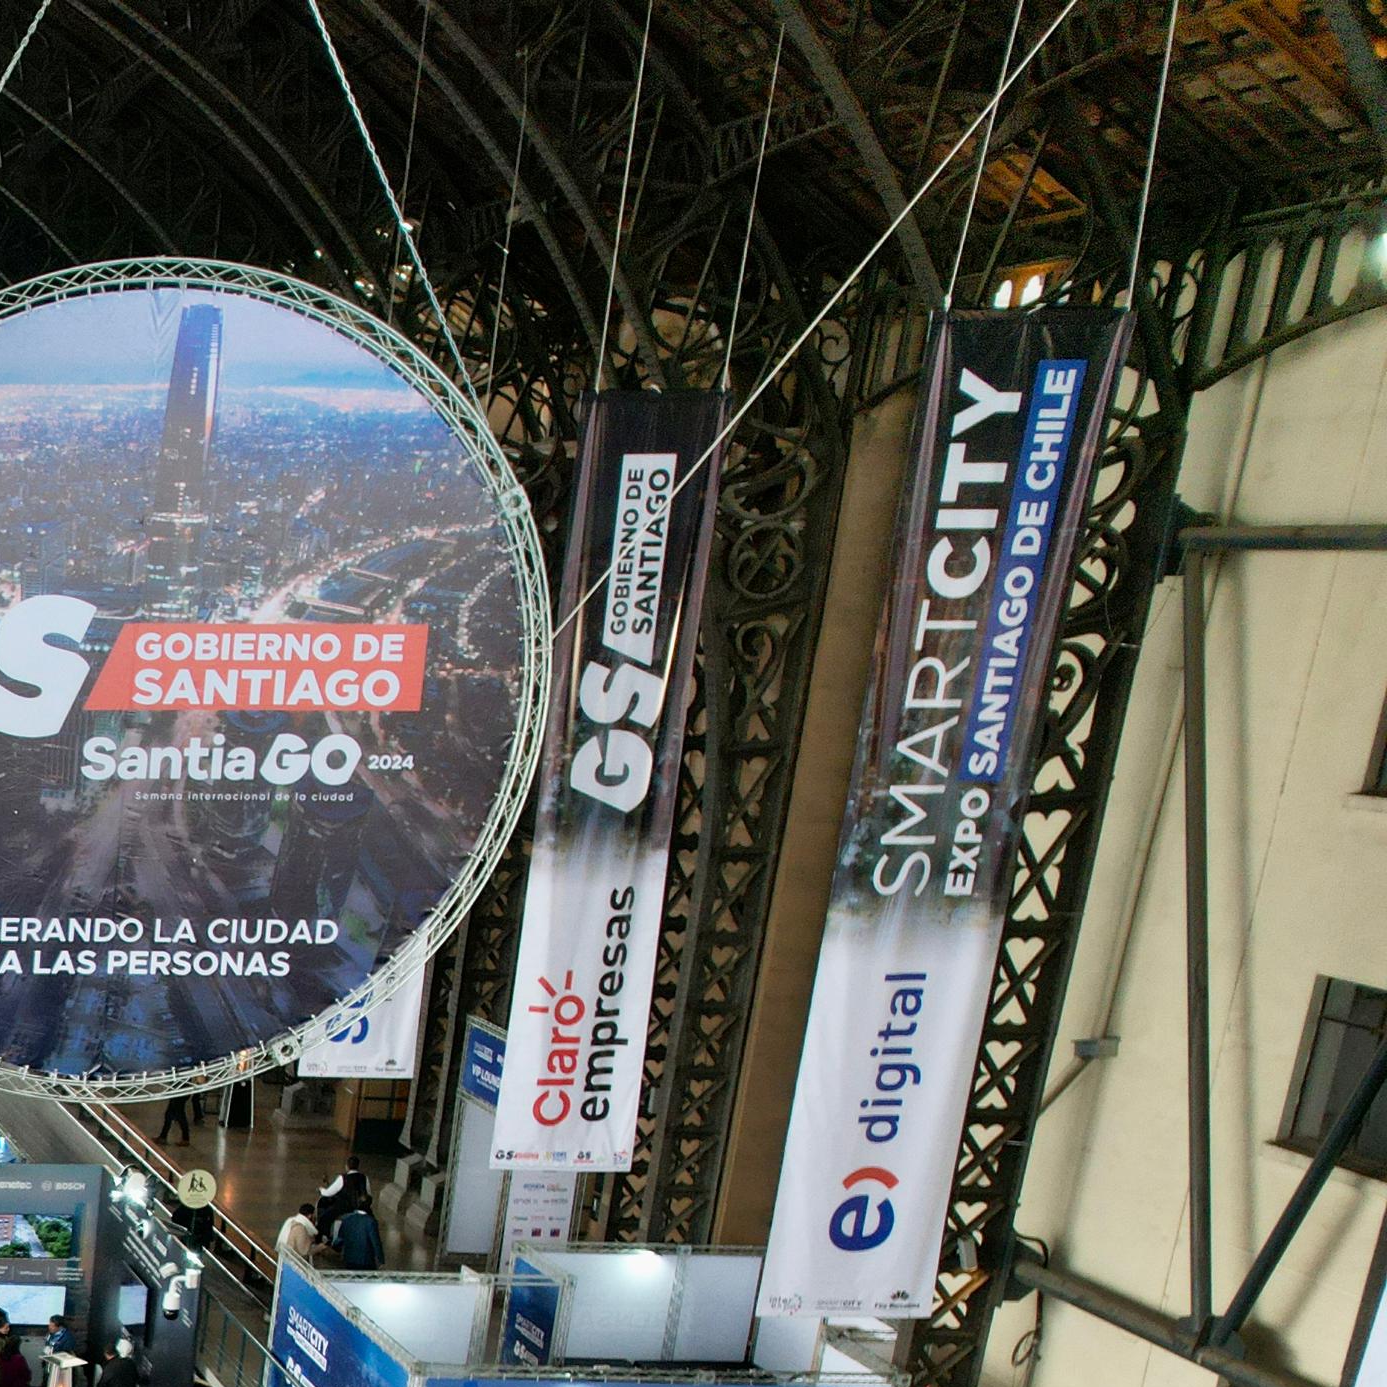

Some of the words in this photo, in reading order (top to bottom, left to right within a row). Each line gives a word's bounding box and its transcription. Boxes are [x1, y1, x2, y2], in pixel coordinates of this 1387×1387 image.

[1026, 366, 1077, 495] CHILE
[610, 507, 639, 636] GOBIERNO
[628, 466, 645, 502] DE
[631, 467, 671, 637] SANTIAGO
[1011, 499, 1049, 558] DE
[132, 668, 401, 707] SANTIAGO
[135, 632, 340, 662] GOBIERNO
[353, 633, 406, 663] DE
[873, 366, 1023, 899] SMARTCITY
[968, 566, 1034, 778] SANTIAGO
[81, 734, 362, 787] SantiaGO
[368, 754, 415, 771] 2024
[570, 659, 665, 814] GS
[134, 790, 183, 801] Semana
[187, 790, 271, 801] internacional
[274, 790, 291, 801] de
[295, 790, 306, 802] la
[311, 790, 355, 803] ciudad
[943, 785, 991, 897] EXPO
[31, 950, 98, 976] LAS
[107, 951, 291, 978] PERSONAS
[154, 919, 197, 944] LA
[206, 919, 339, 945] CIUDAD
[579, 885, 637, 1123] empresas
[857, 971, 929, 1144] digital
[532, 994, 587, 1128] Claro
[55, 1182, 86, 1191] BOSCH
[287, 1306, 329, 1355] SMARTCITY
